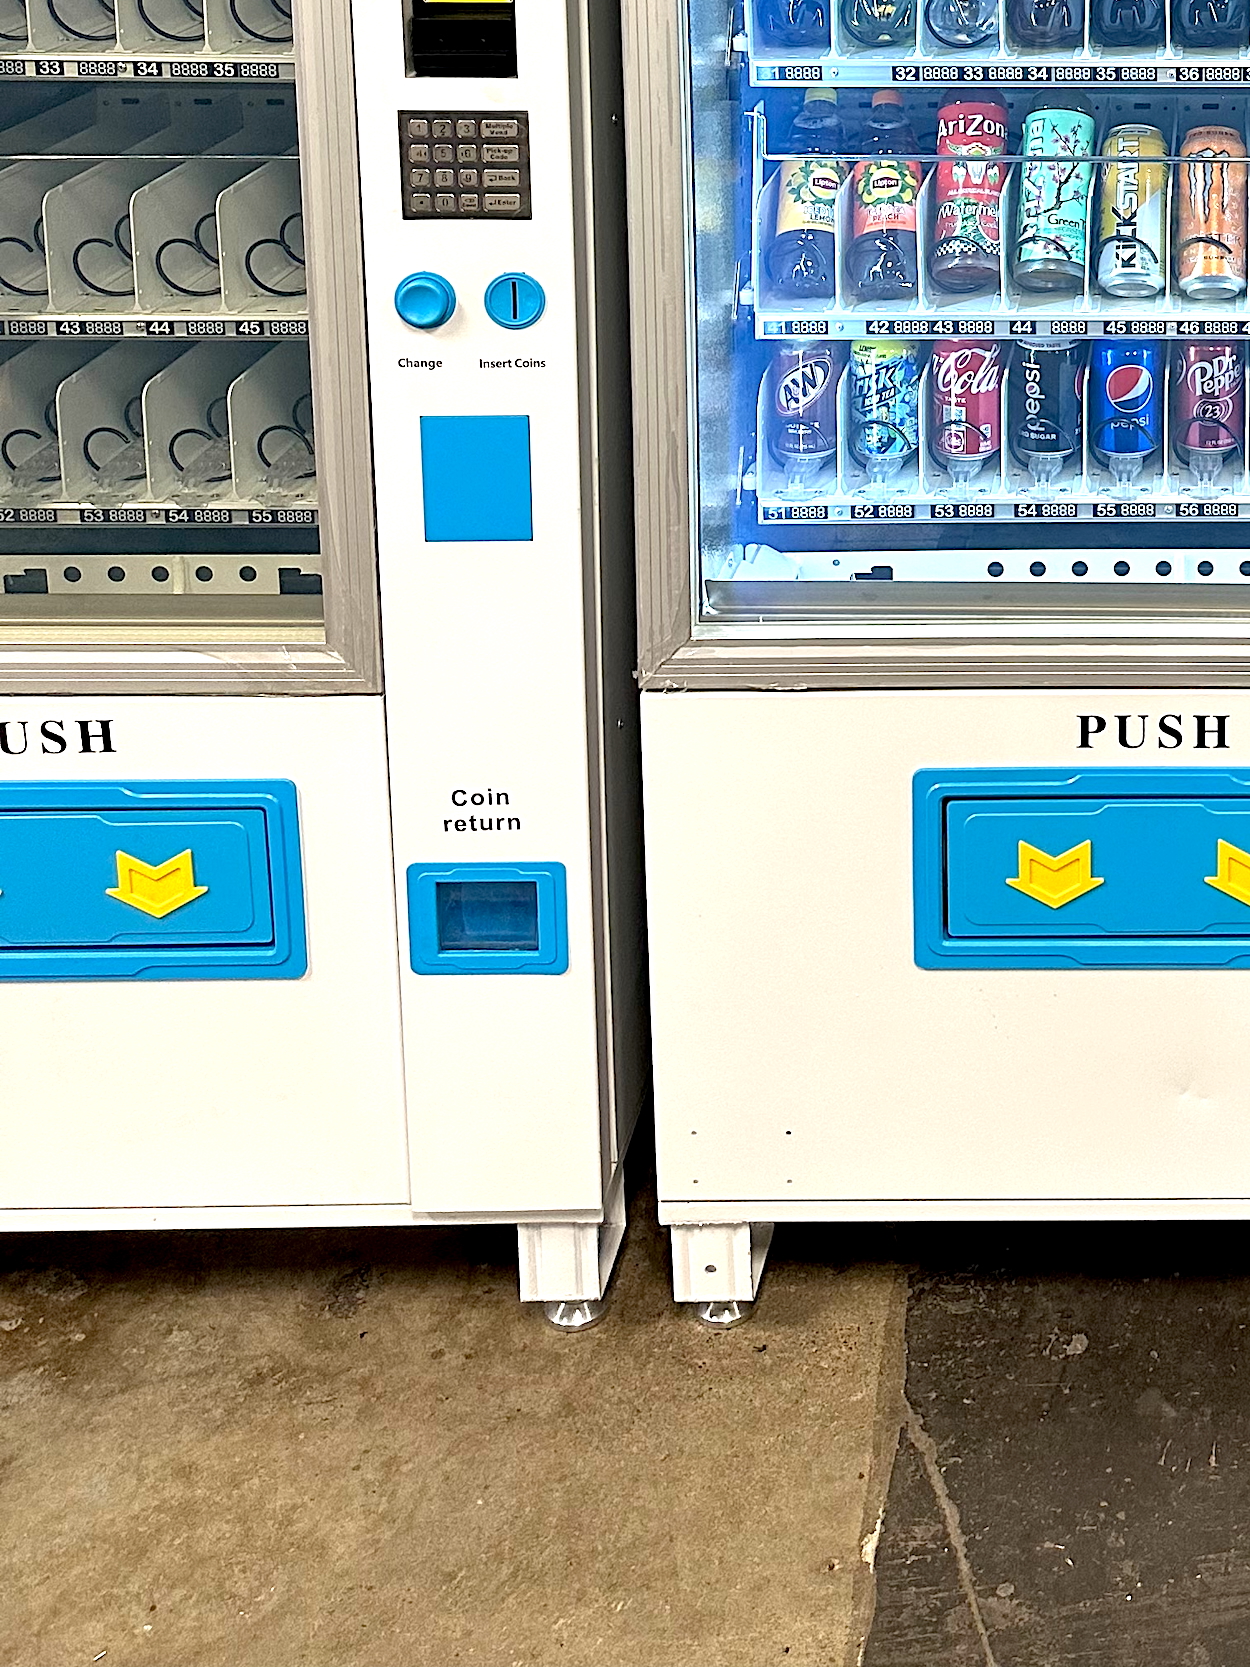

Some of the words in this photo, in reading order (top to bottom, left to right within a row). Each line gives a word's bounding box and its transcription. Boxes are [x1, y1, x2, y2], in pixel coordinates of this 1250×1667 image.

[213, 63, 235, 77] 35
[240, 64, 278, 77] 8888
[1179, 68, 1199, 81] 36
[1206, 68, 1240, 81] 8888
[814, 178, 838, 189] Lipton
[873, 179, 899, 188] Lipton
[1047, 213, 1080, 227] Green
[59, 322, 81, 334] 43
[85, 321, 122, 334] 8888
[934, 321, 953, 333] 43
[958, 320, 992, 333] 8888
[398, 358, 443, 370] Change
[479, 359, 512, 368] Insert
[514, 359, 546, 368] Coins
[1212, 354, 1237, 376] Dr
[783, 363, 819, 411] A&W
[1022, 361, 1046, 433] pepsi
[1204, 404, 1221, 419] 23
[1110, 414, 1150, 431] pepsi
[1029, 432, 1057, 441] SUGAR
[252, 510, 273, 523] 55
[277, 510, 313, 523] 8888
[935, 506, 954, 518] 53
[958, 505, 993, 518] 8888
[1076, 714, 1232, 749] PUSH
[451, 788, 510, 807] Coin
[443, 814, 521, 832] return
